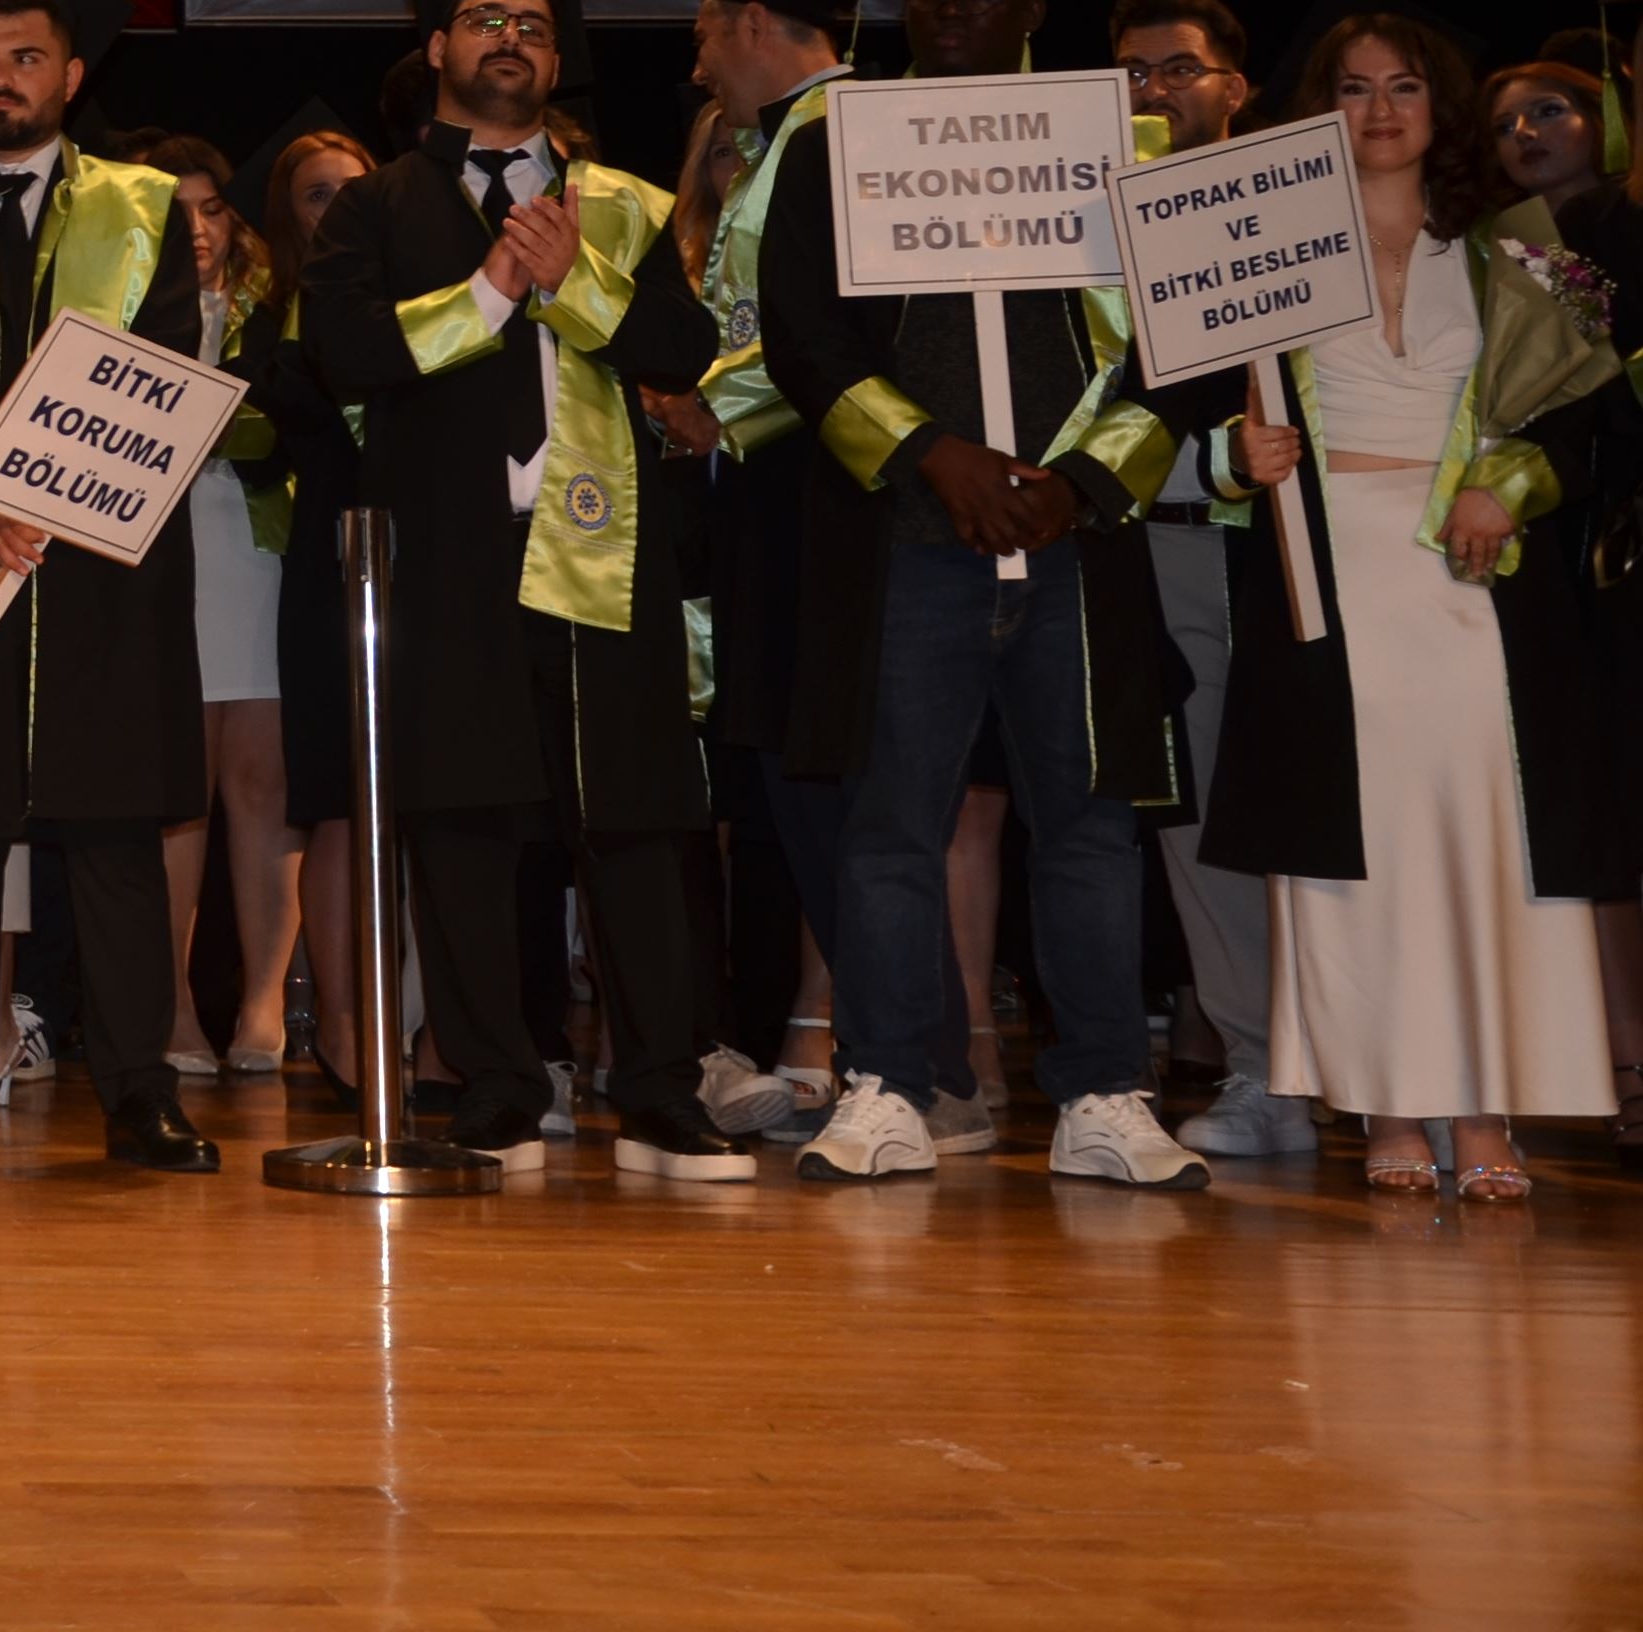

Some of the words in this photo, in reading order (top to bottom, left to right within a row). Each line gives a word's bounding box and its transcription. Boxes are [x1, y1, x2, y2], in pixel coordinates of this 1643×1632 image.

[908, 112, 1051, 145] TARIM
[856, 154, 1111, 201] EKONOMİSİ
[1136, 177, 1246, 224] TOPRAK
[1252, 149, 1334, 196] BİLİMİ
[892, 210, 1085, 252] BÖLÜMÜ
[1225, 215, 1262, 242] VE
[1150, 261, 1223, 304] BİTKİ
[1230, 231, 1351, 282] BESLEME
[1202, 278, 1311, 331] BÖLÜMÜ
[88, 354, 189, 414] BİTKİ
[29, 395, 175, 474] KORUMA
